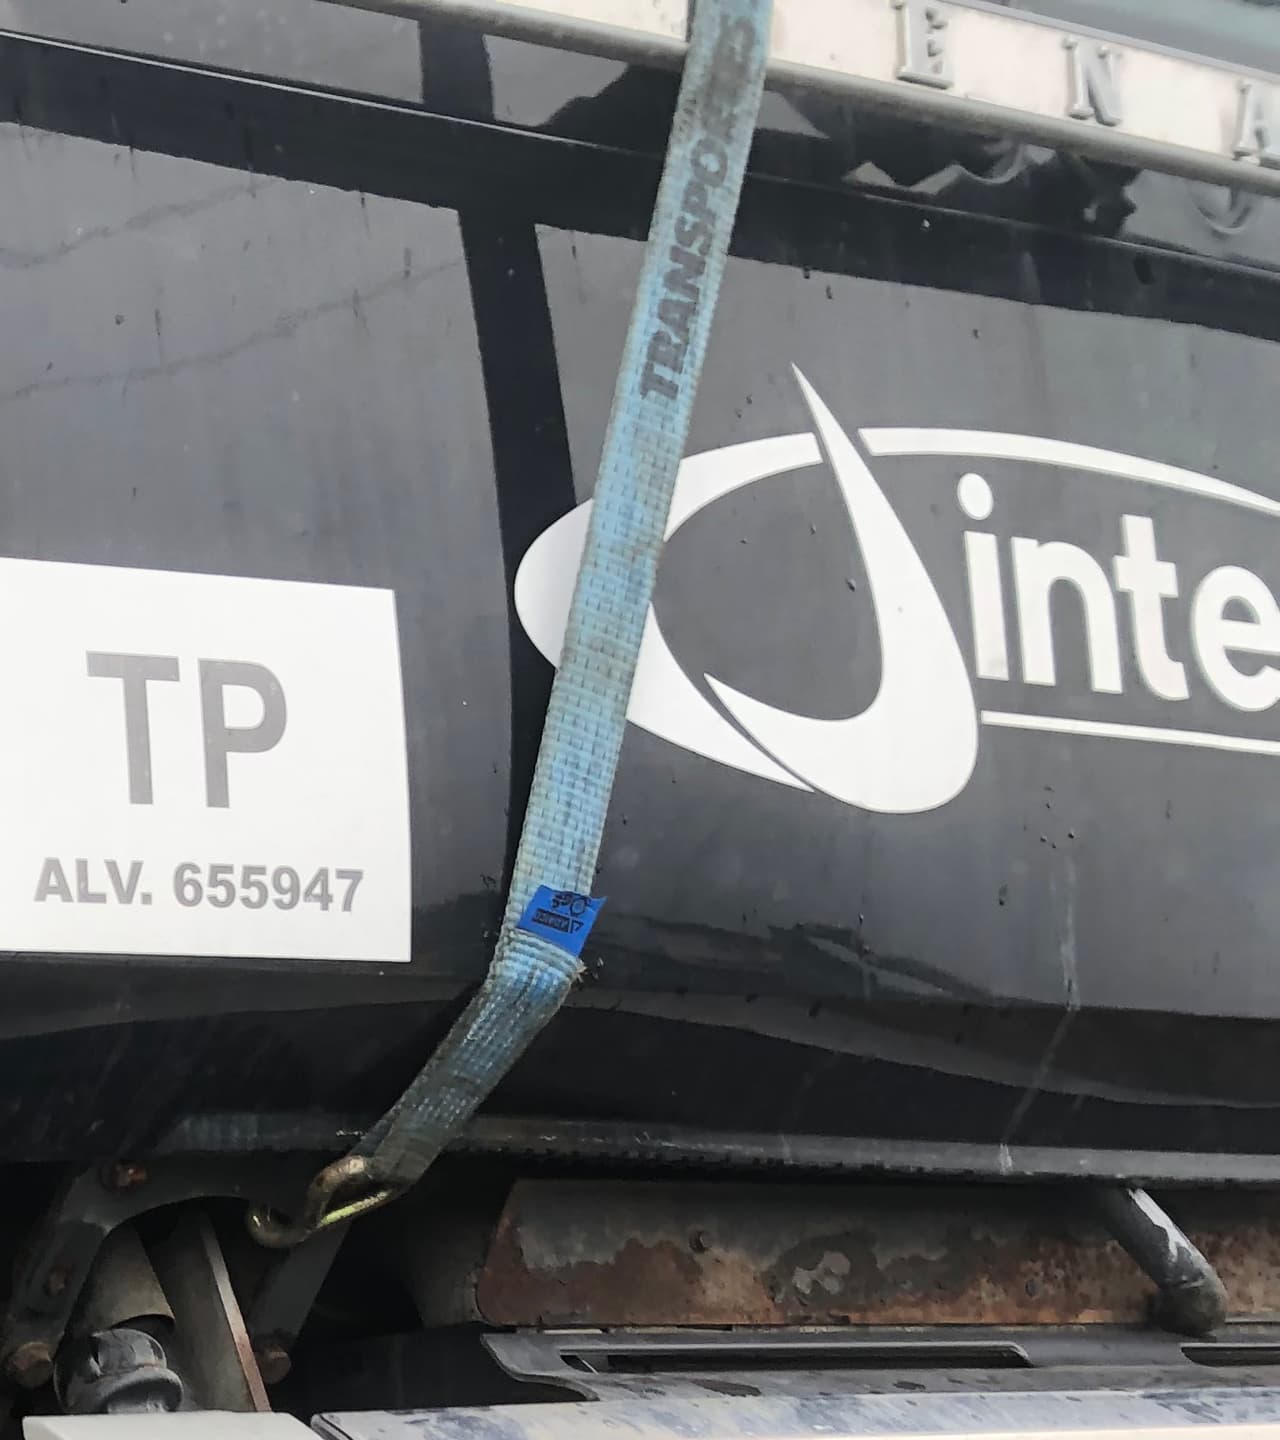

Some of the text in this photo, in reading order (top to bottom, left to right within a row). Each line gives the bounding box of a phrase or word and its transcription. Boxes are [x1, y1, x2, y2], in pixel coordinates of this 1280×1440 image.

[957, 472, 1280, 712] inte
[85, 650, 287, 808] TP
[33, 857, 364, 912] ALV. 655947
